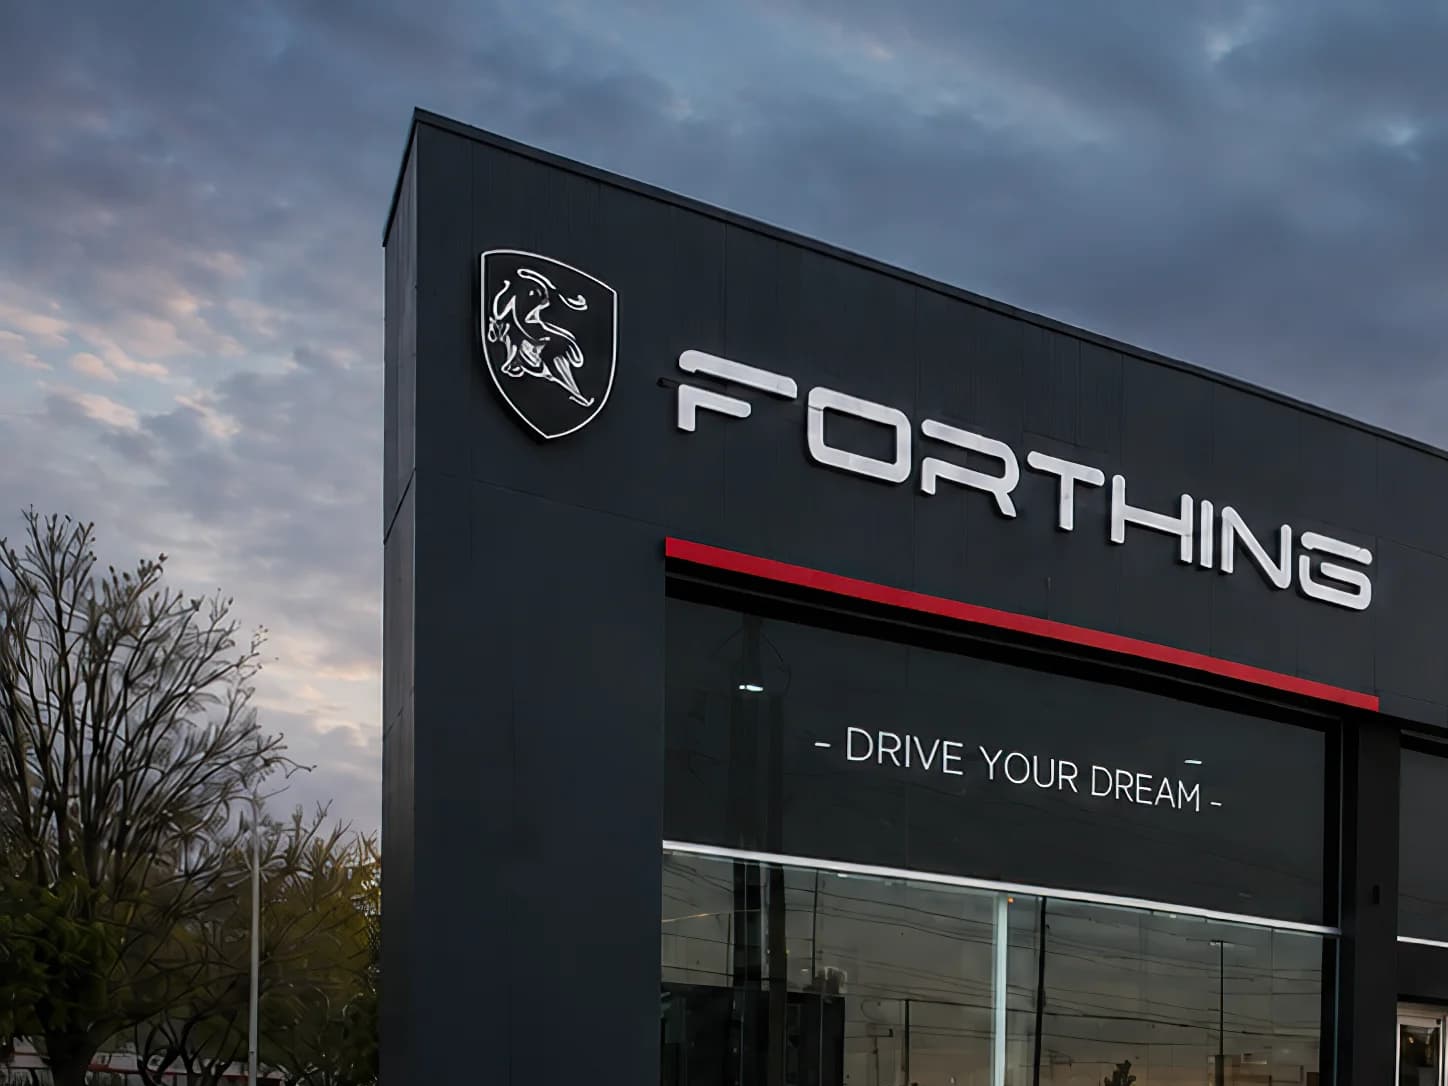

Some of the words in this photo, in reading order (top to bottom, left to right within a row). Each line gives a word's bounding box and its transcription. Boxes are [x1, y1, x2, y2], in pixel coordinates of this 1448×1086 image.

[677, 349, 1374, 611] FORTHING
[846, 726, 964, 776] DRIVE
[979, 745, 1078, 793] YOUR
[1091, 764, 1200, 812] DREAM
